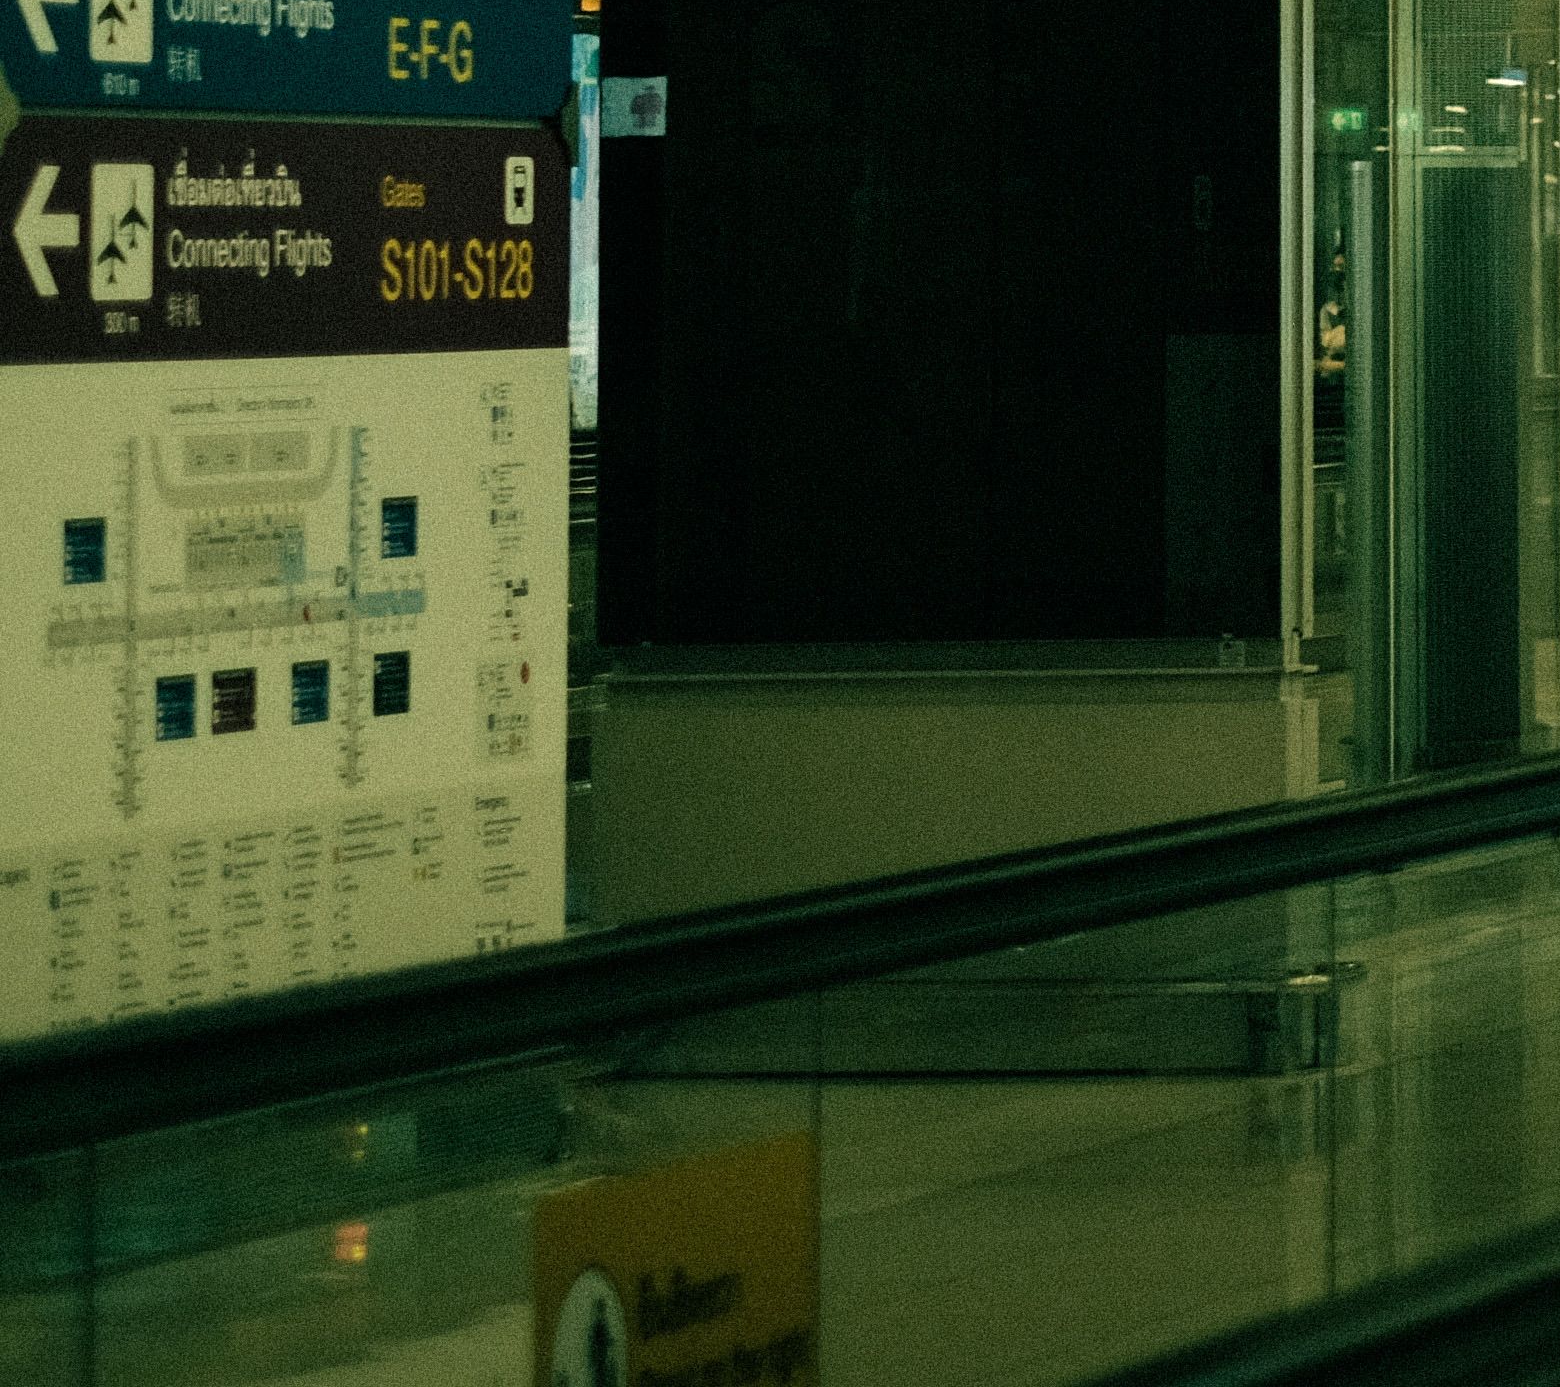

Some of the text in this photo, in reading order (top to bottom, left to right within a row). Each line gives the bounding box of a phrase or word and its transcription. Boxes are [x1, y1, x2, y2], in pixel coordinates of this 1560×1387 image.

[388, 17, 473, 83] E-F-G
[167, 229, 332, 277] Connecting Flights
[381, 238, 533, 301] S101-S128
